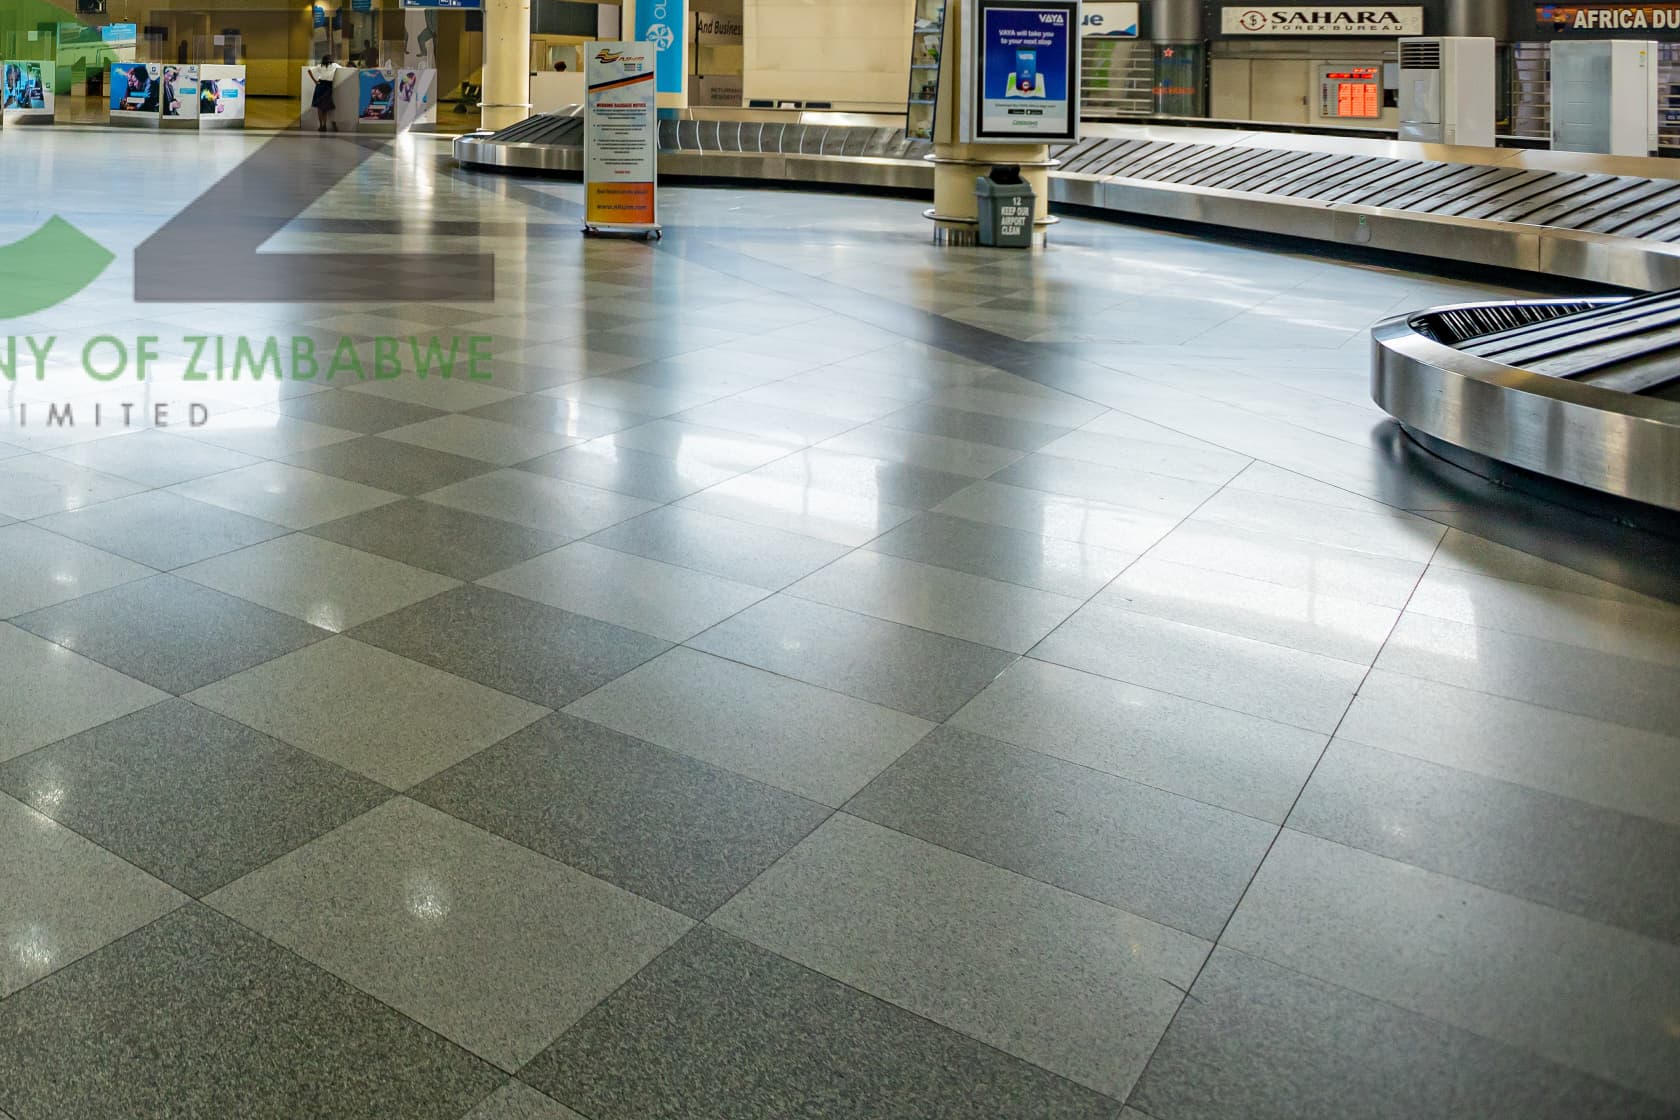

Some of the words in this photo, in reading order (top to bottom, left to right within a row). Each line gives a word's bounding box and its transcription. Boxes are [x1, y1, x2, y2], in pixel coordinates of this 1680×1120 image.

[1038, 13, 1064, 23] VAYA
[1271, 11, 1401, 24] SAHARA
[1573, 9, 1648, 29] AFRICA
[1652, 9, 1680, 29] DU
[698, 19, 714, 34] And
[1012, 196, 1022, 206] 12
[1001, 206, 1017, 216] KEEP
[1001, 226, 1021, 236] CLEAN
